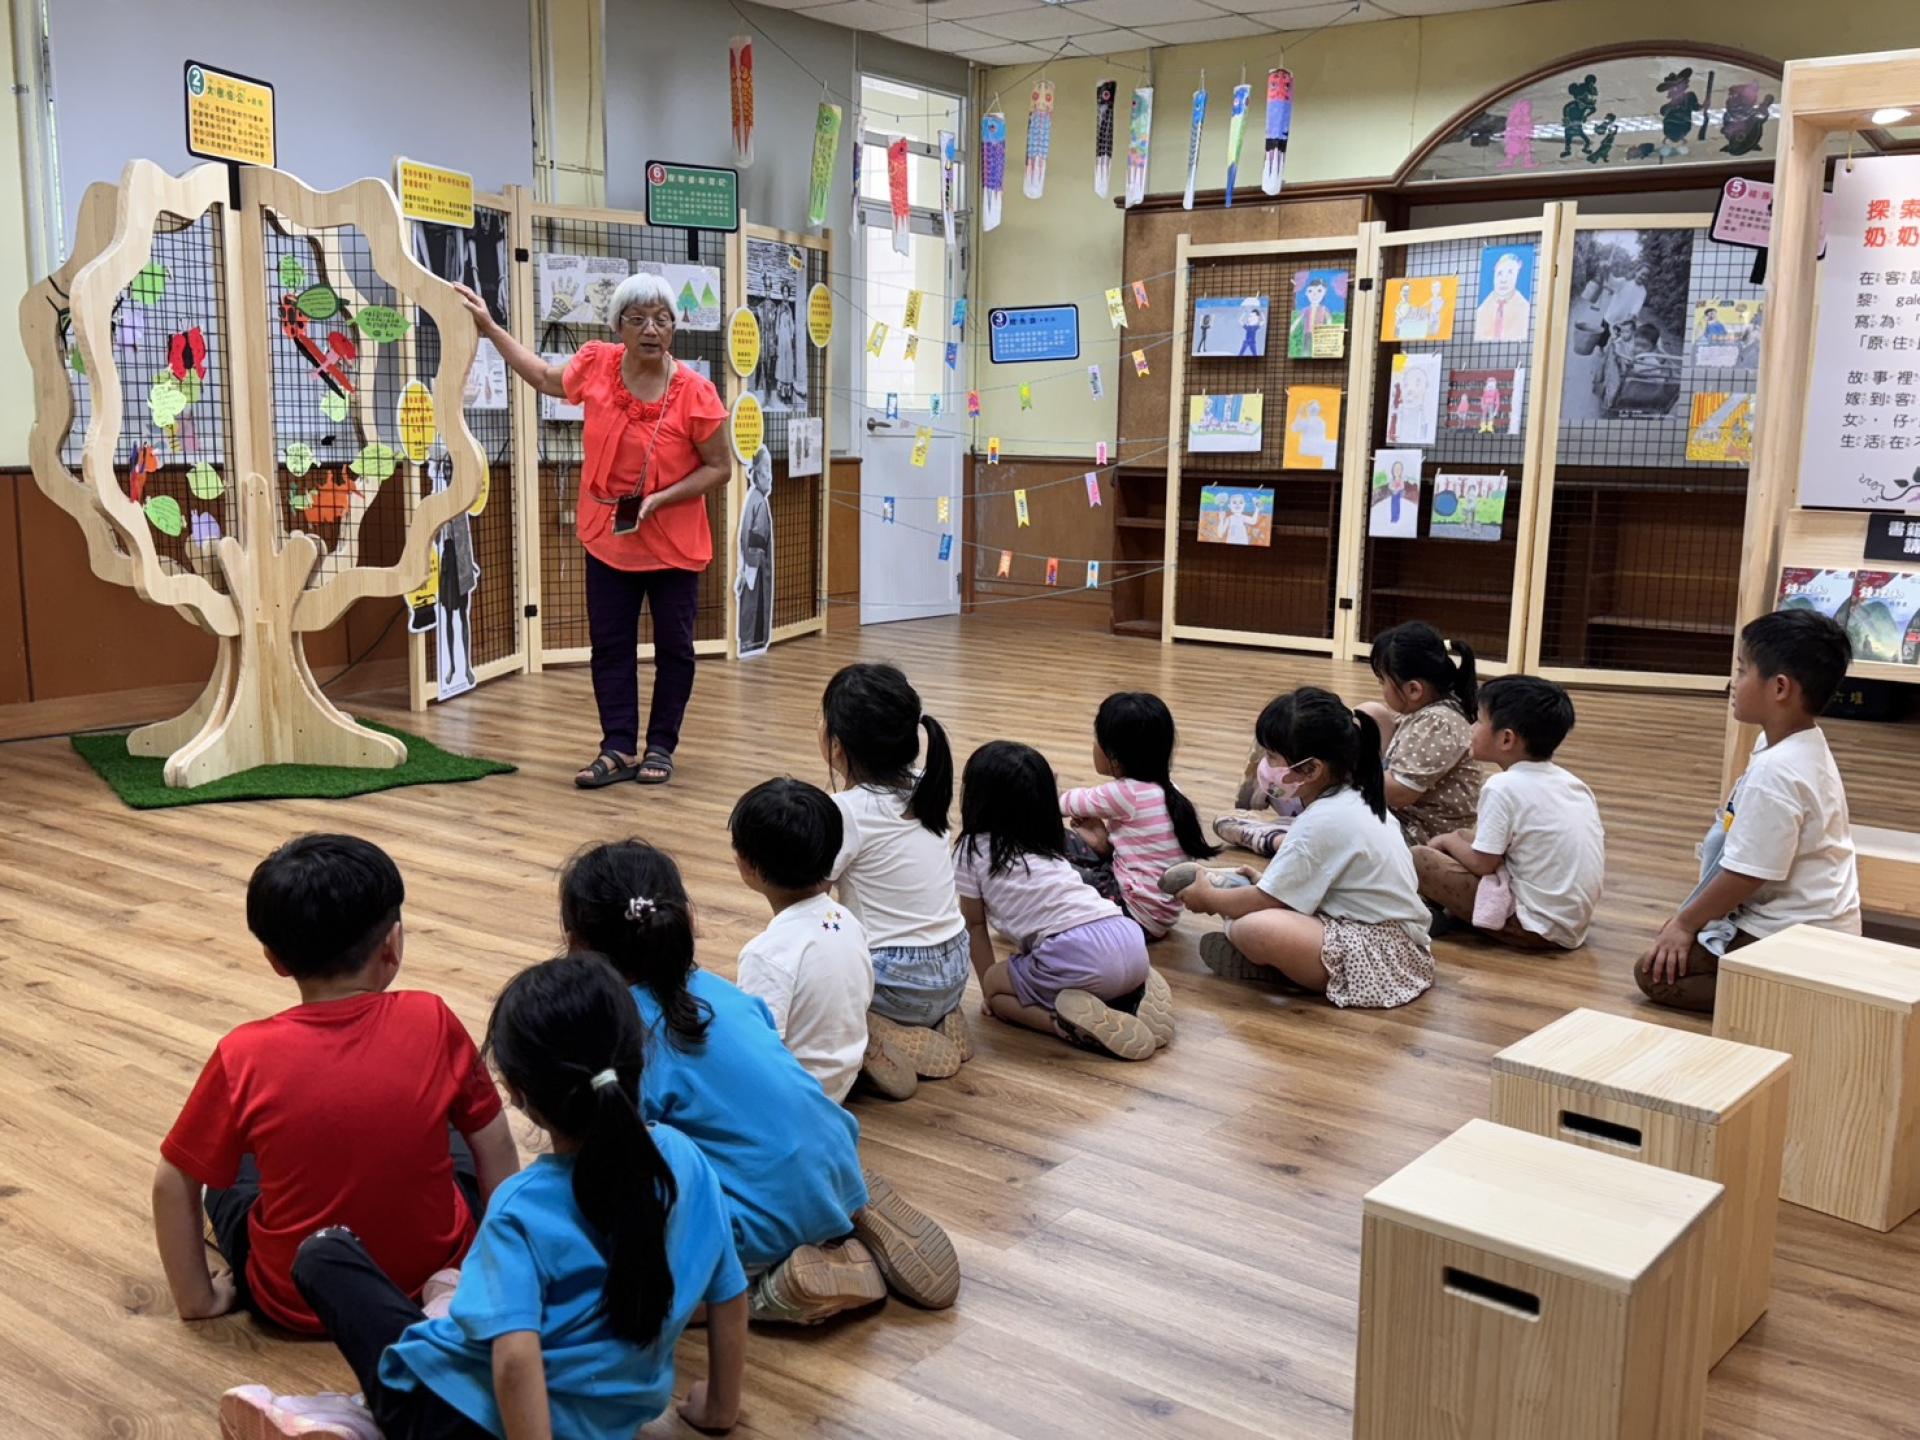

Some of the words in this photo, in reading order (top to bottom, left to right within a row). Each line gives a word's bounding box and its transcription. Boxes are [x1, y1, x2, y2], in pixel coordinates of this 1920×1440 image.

[192, 69, 201, 87] 2
[653, 167, 662, 178] 6
[1731, 179, 1744, 192] 5
[1866, 199, 1920, 221] 探索
[1863, 226, 1919, 247] 奶奶
[995, 312, 1004, 323] 3
[1859, 334, 1920, 350] 「原住
[1847, 370, 1913, 385] 故事裡
[1844, 392, 1911, 407] 嫁到客
